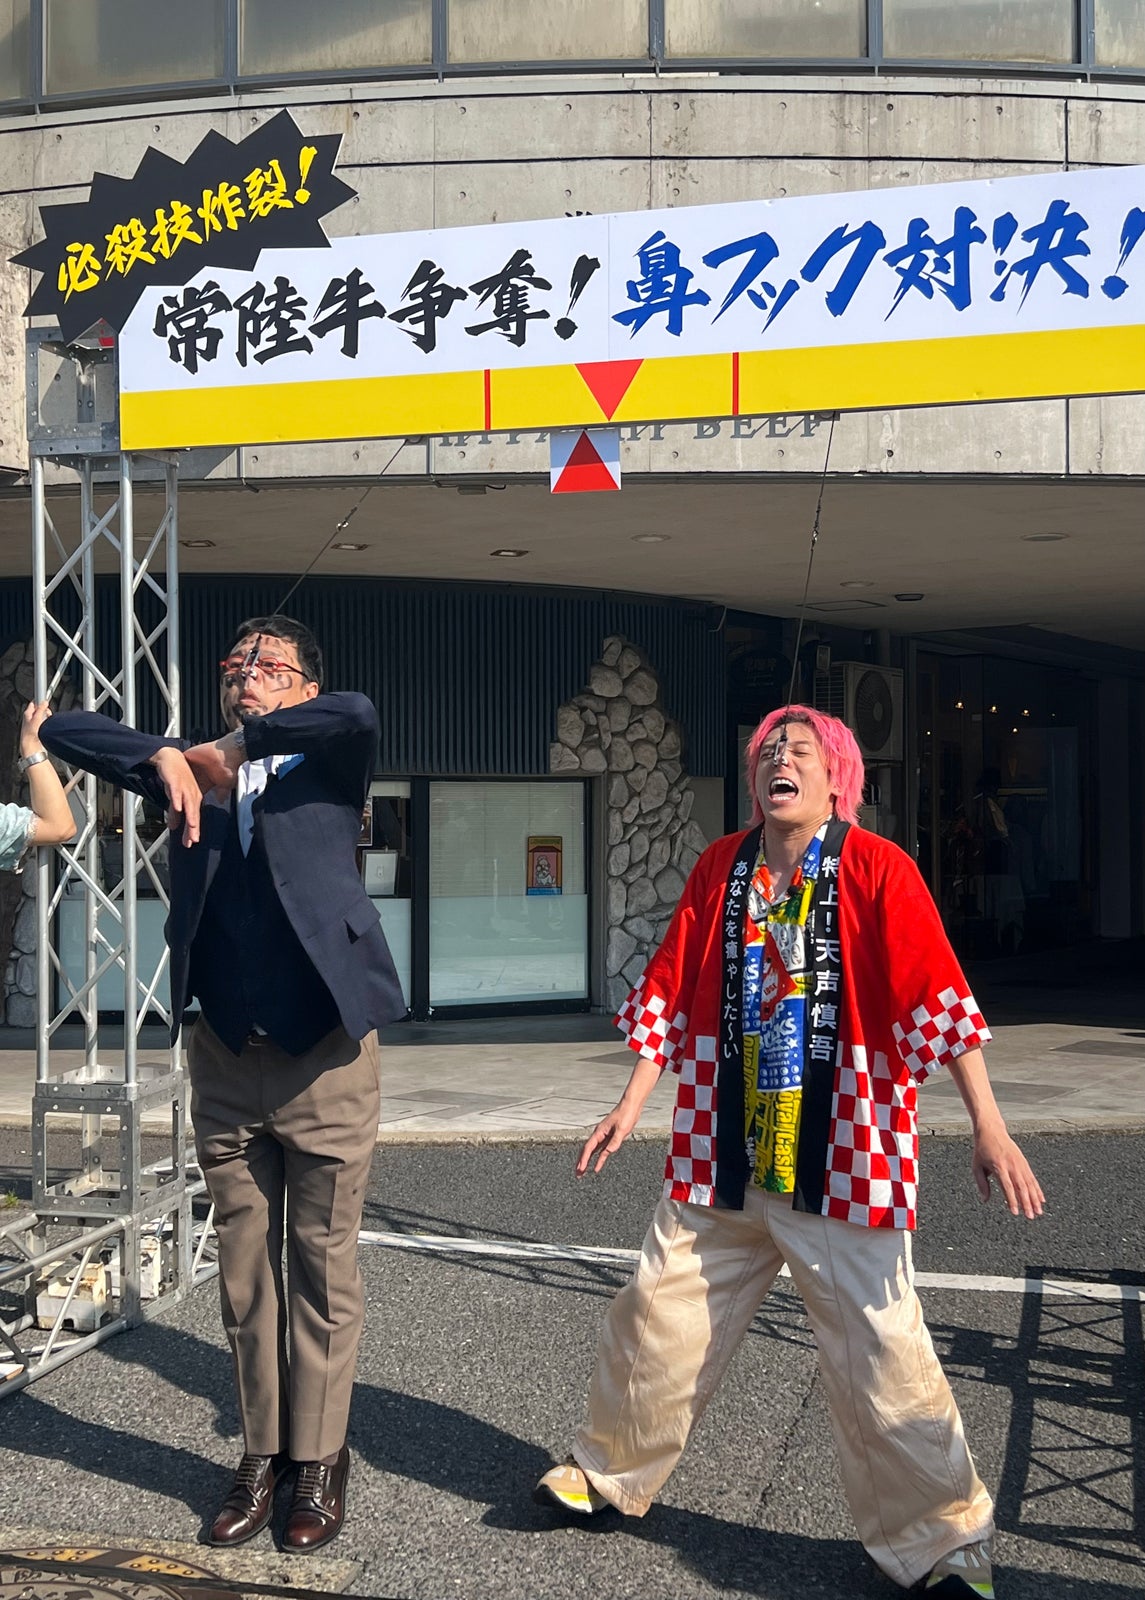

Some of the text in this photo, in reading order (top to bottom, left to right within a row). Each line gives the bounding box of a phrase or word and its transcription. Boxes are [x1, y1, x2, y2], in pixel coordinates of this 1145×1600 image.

[57, 145, 319, 303] 必殺技炸裂!
[152, 198, 1145, 375] 常陸牛争奪! 鼻フック対決!
